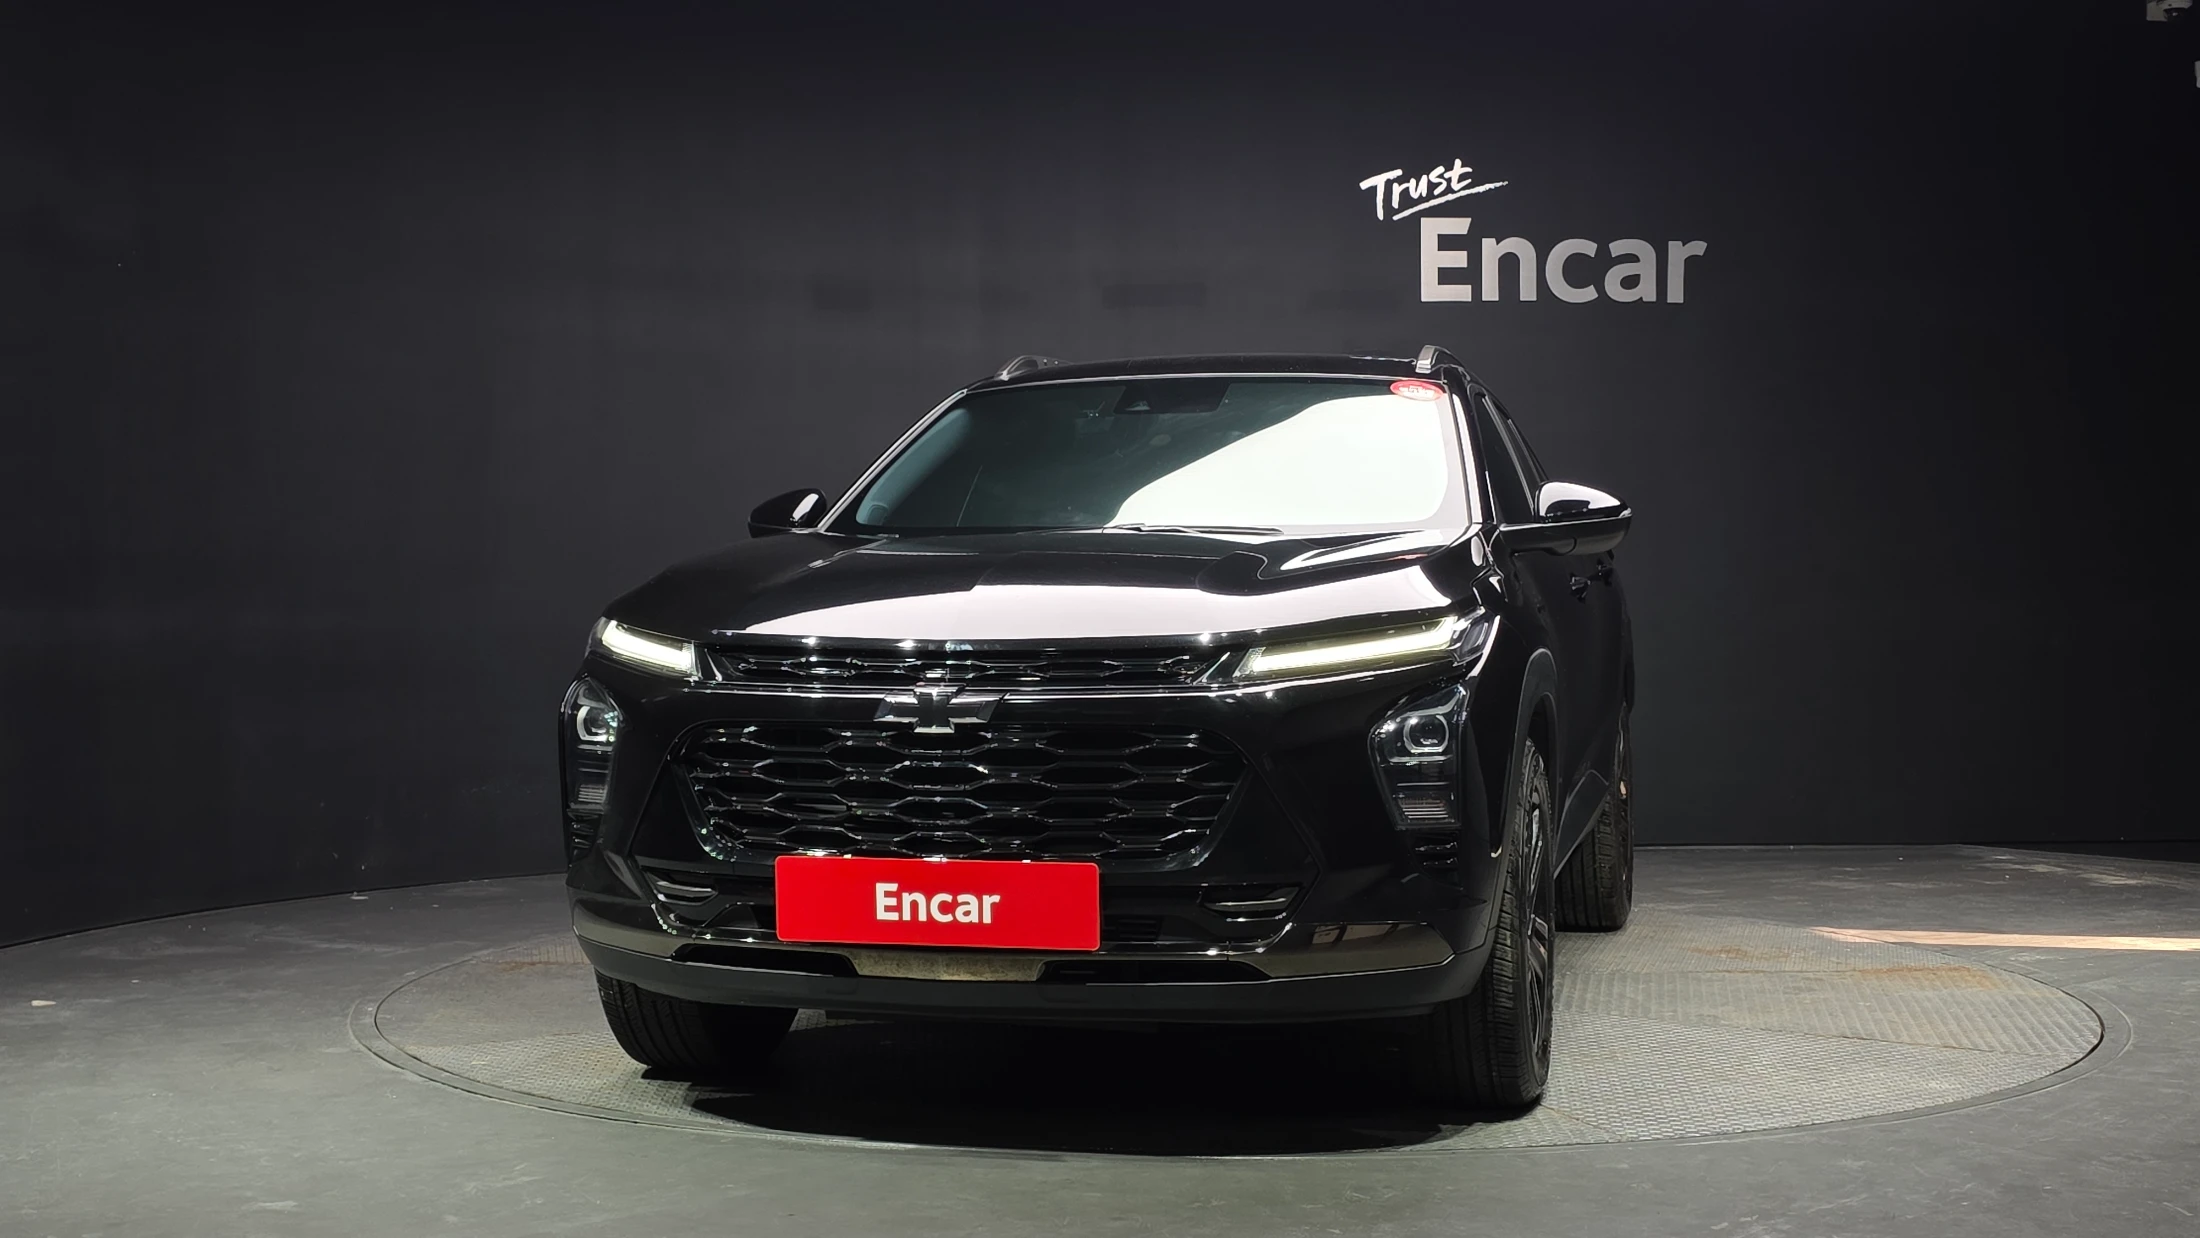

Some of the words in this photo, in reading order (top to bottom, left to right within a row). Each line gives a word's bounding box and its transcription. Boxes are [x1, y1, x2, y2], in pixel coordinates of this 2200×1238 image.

[1358, 158, 1474, 221] Trust
[1420, 217, 1707, 304] Encar
[874, 882, 1001, 924] Encar
